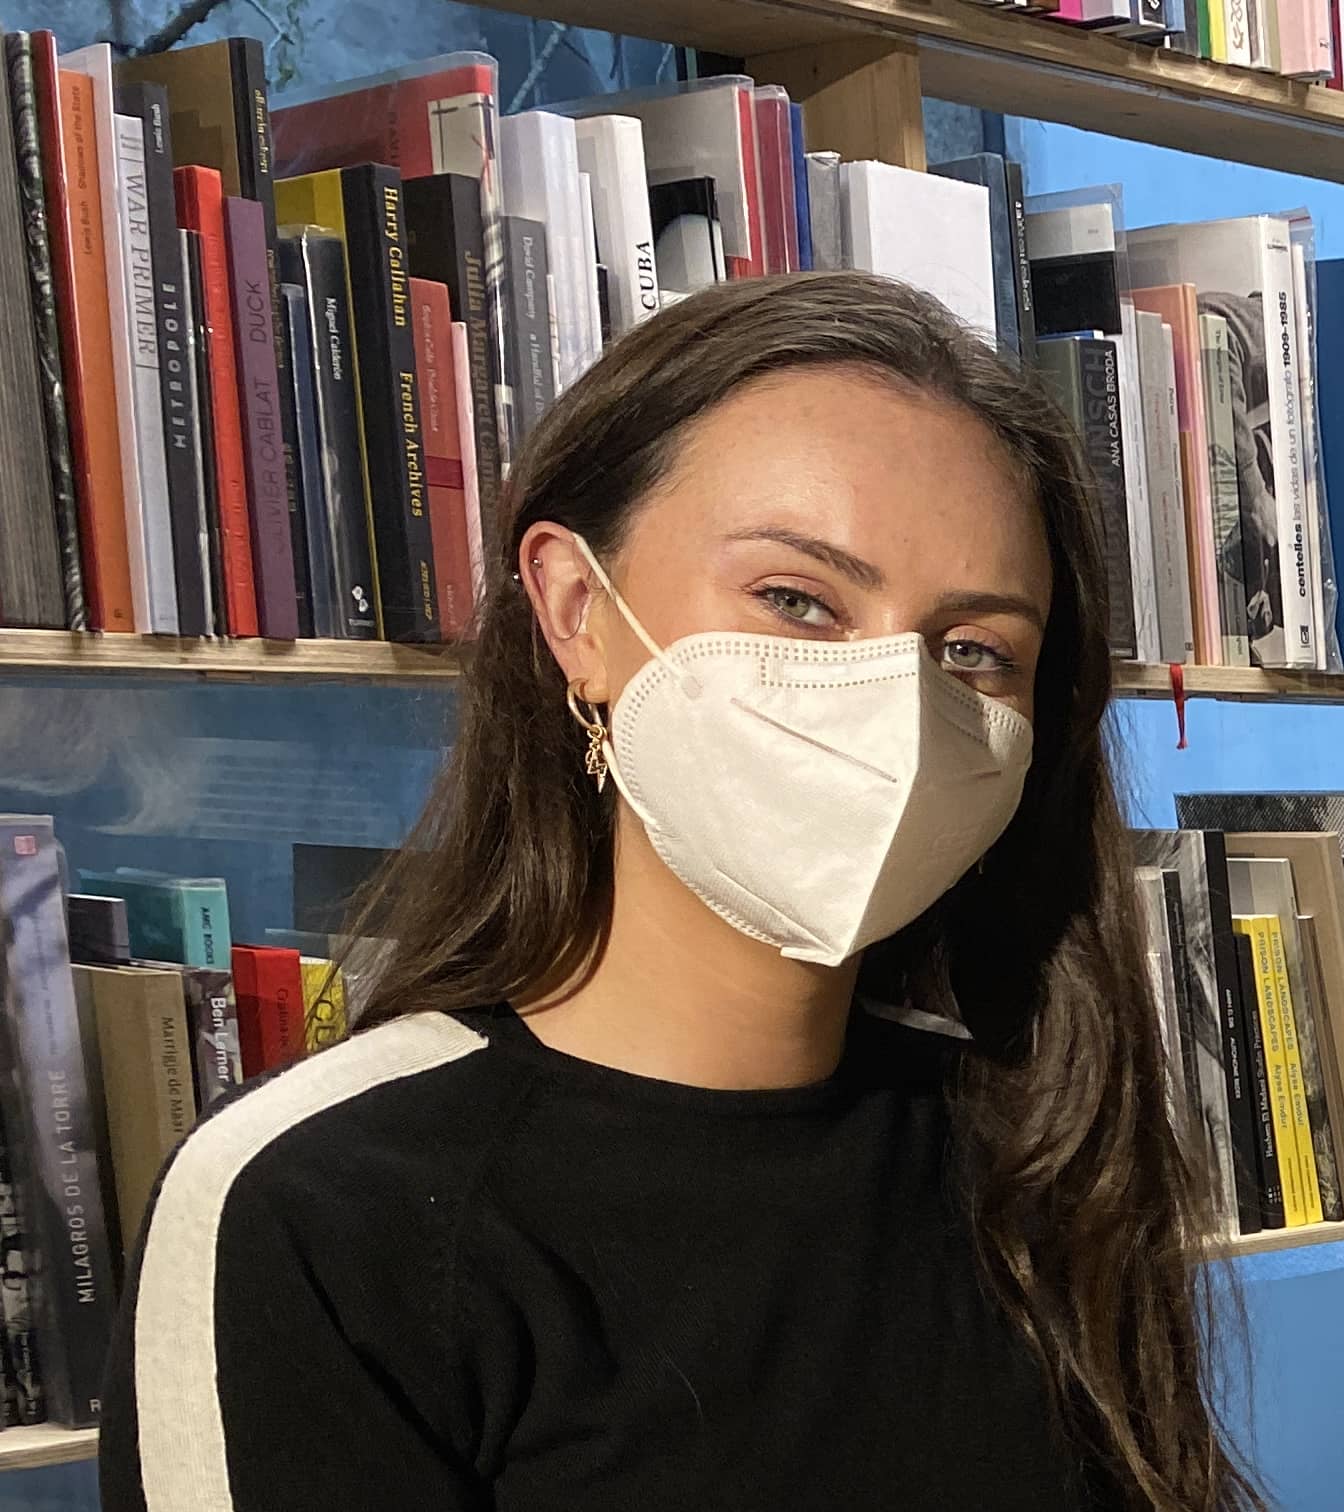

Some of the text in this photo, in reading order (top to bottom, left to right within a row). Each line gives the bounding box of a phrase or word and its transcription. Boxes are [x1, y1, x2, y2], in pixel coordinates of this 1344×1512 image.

[125, 173, 148, 235] WAR
[464, 251, 485, 312] Julia
[523, 236, 535, 267] David
[635, 241, 657, 311] CUBA
[130, 244, 156, 354] PRIMER
[244, 279, 268, 344] DUCK
[325, 296, 339, 334] Miguel
[523, 269, 538, 320] Campany
[162, 282, 188, 449] METROPOLE
[382, 186, 423, 518] Harry Callahan French Archives
[468, 315, 494, 426] Margaret
[530, 343, 544, 386] Handful
[254, 377, 278, 463] CABLAT
[1104, 350, 1121, 467] ANA CASAS BRODA
[1287, 428, 1297, 447] un
[1287, 448, 1299, 465] de
[1288, 467, 1301, 501] vidas
[1292, 523, 1307, 598] centelles
[1257, 931, 1270, 974] PRISON
[1271, 931, 1284, 973] PRISON
[210, 996, 231, 1083] Ben Lerner
[1262, 978, 1281, 1052] LANDSCAPES
[1276, 977, 1295, 1050] LANDSCAPES
[167, 1078, 181, 1096] de
[49, 1069, 96, 1304] MILAGROS DE LA TORRE
